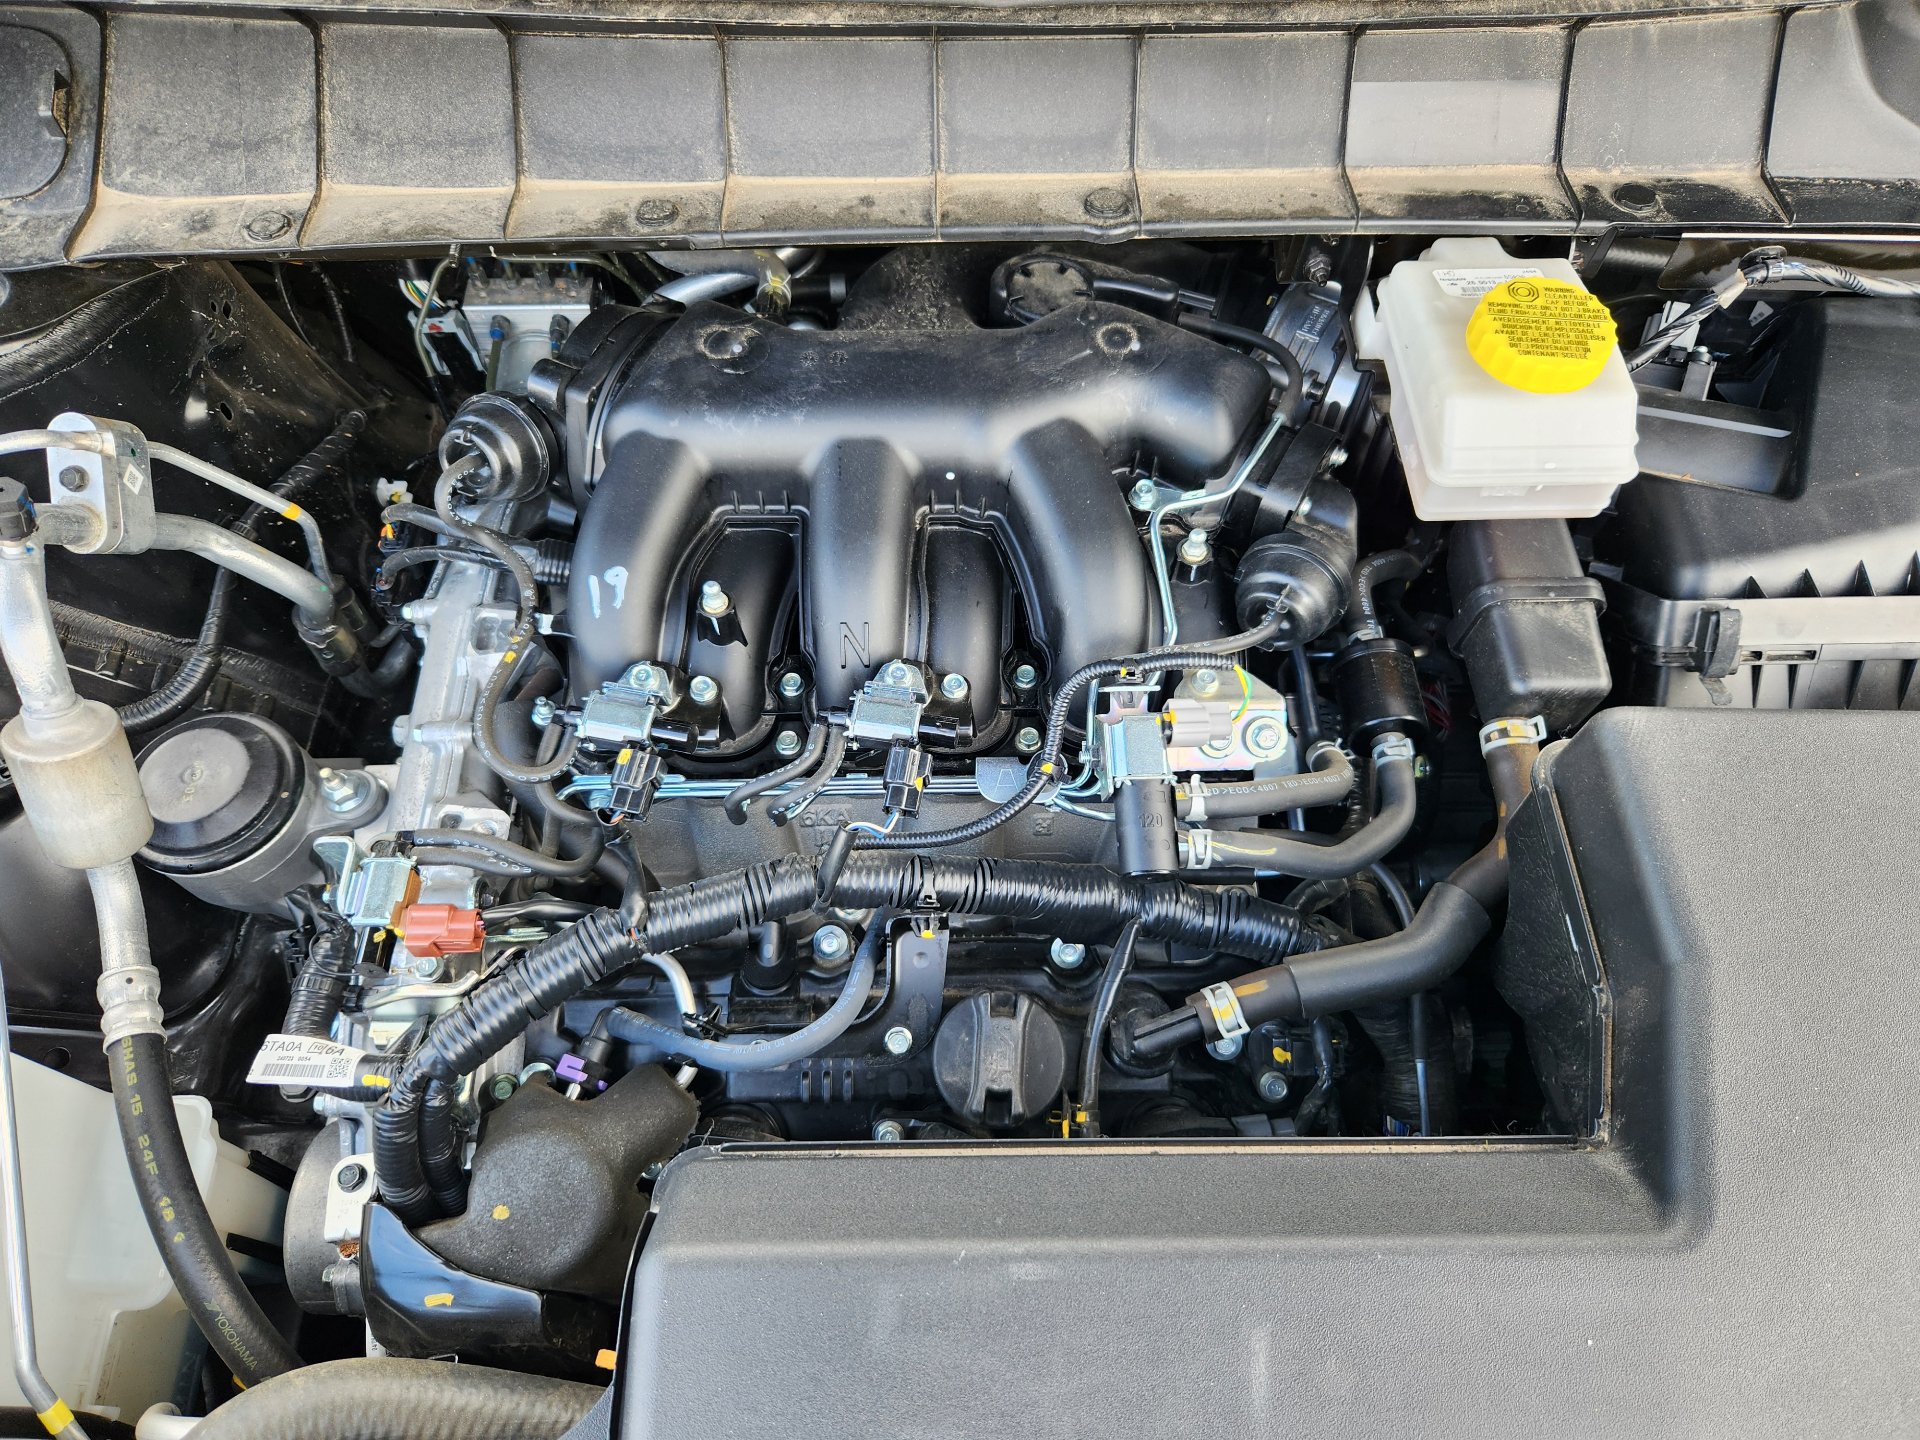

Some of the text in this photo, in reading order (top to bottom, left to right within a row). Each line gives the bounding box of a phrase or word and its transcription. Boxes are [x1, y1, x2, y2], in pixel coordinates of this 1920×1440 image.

[1546, 326, 1594, 334] REMPLISSAGE
[588, 566, 629, 618] 19
[839, 621, 871, 669] N
[993, 768, 1020, 798] A
[1139, 813, 1163, 828] 120
[325, 1045, 345, 1056] 6A
[130, 1093, 144, 1117] 15
[137, 1134, 159, 1177] 24F
[213, 1314, 258, 1371] YOKOHAMA
